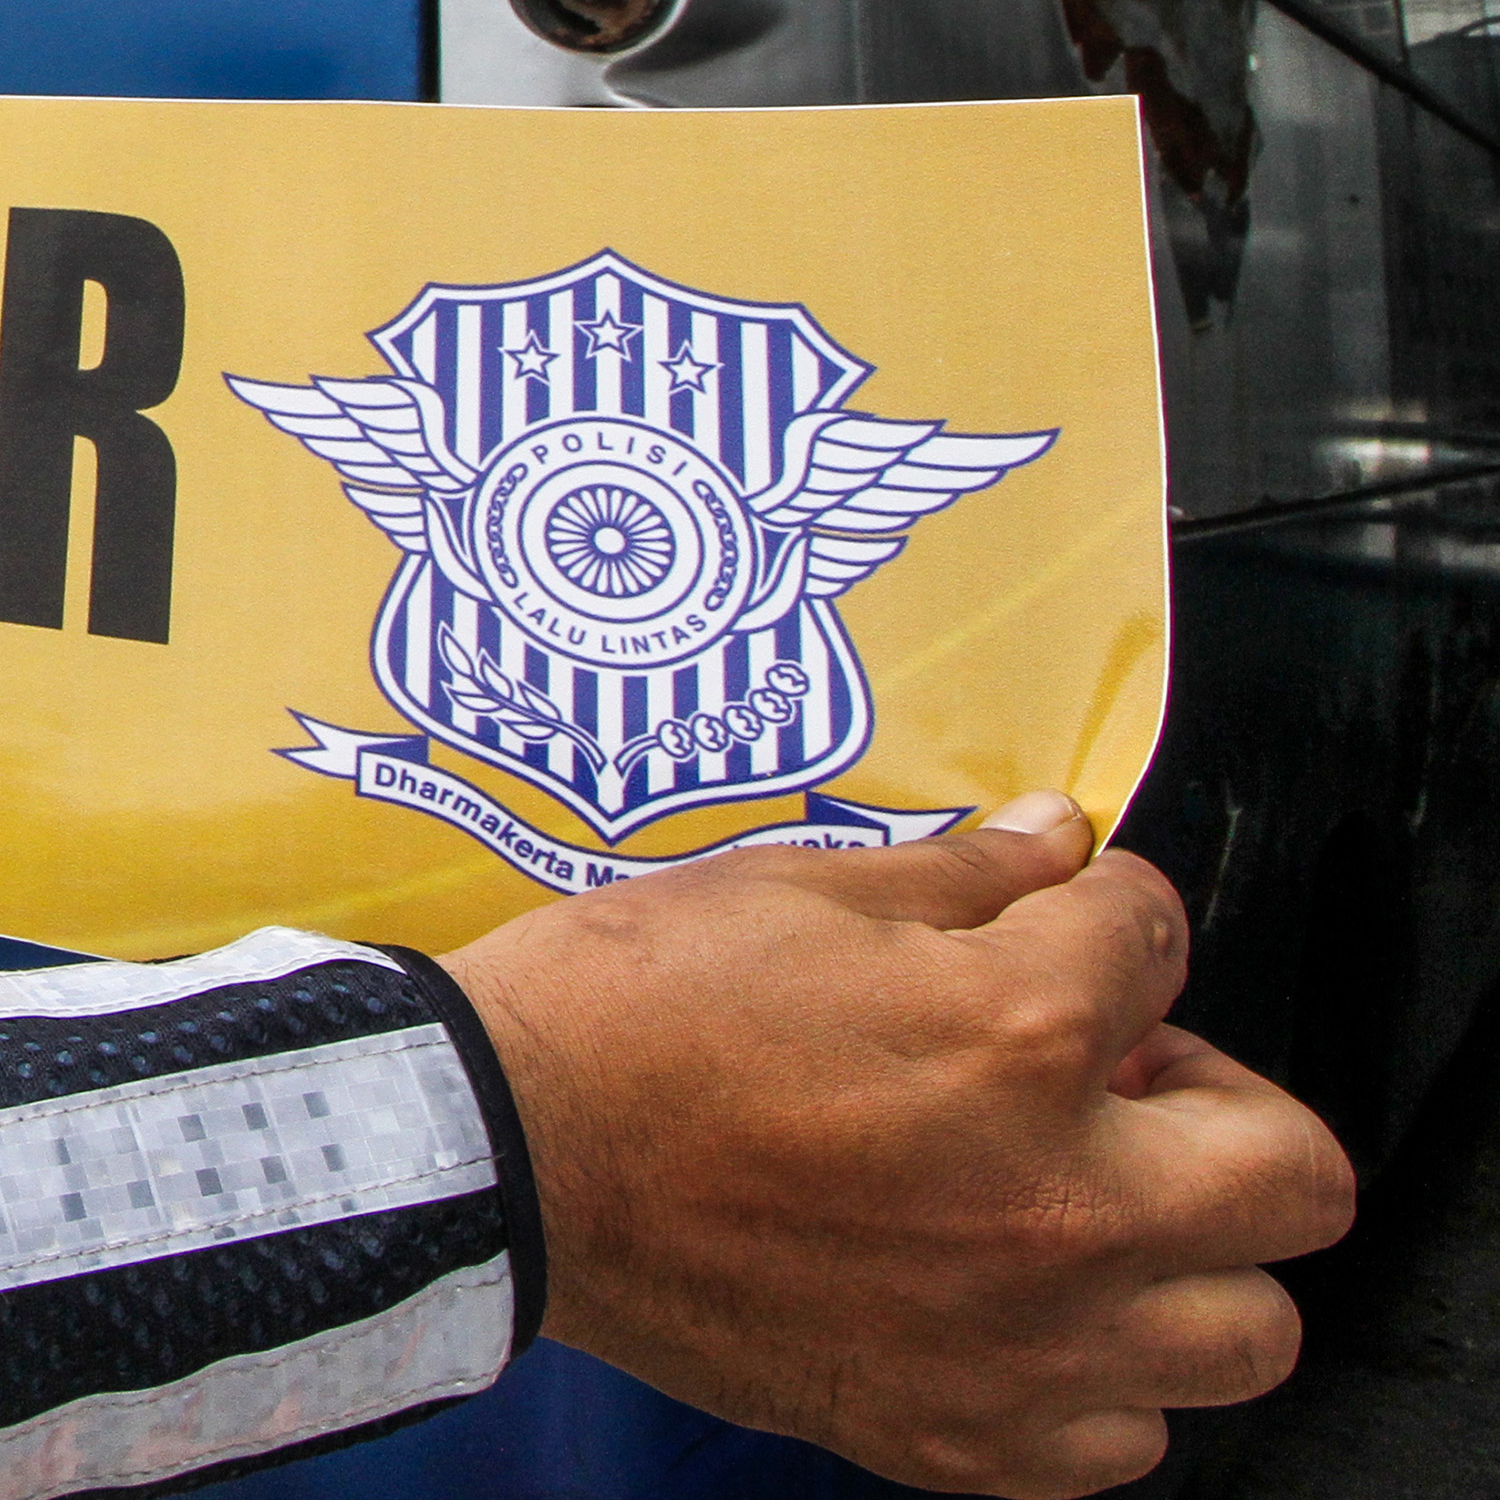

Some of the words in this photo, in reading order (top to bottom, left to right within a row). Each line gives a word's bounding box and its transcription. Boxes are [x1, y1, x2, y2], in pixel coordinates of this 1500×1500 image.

[531, 431, 688, 477] POLISI
[513, 591, 587, 646] LALU
[600, 613, 708, 655] LINTAS
[374, 761, 573, 881] Dharmakerta
